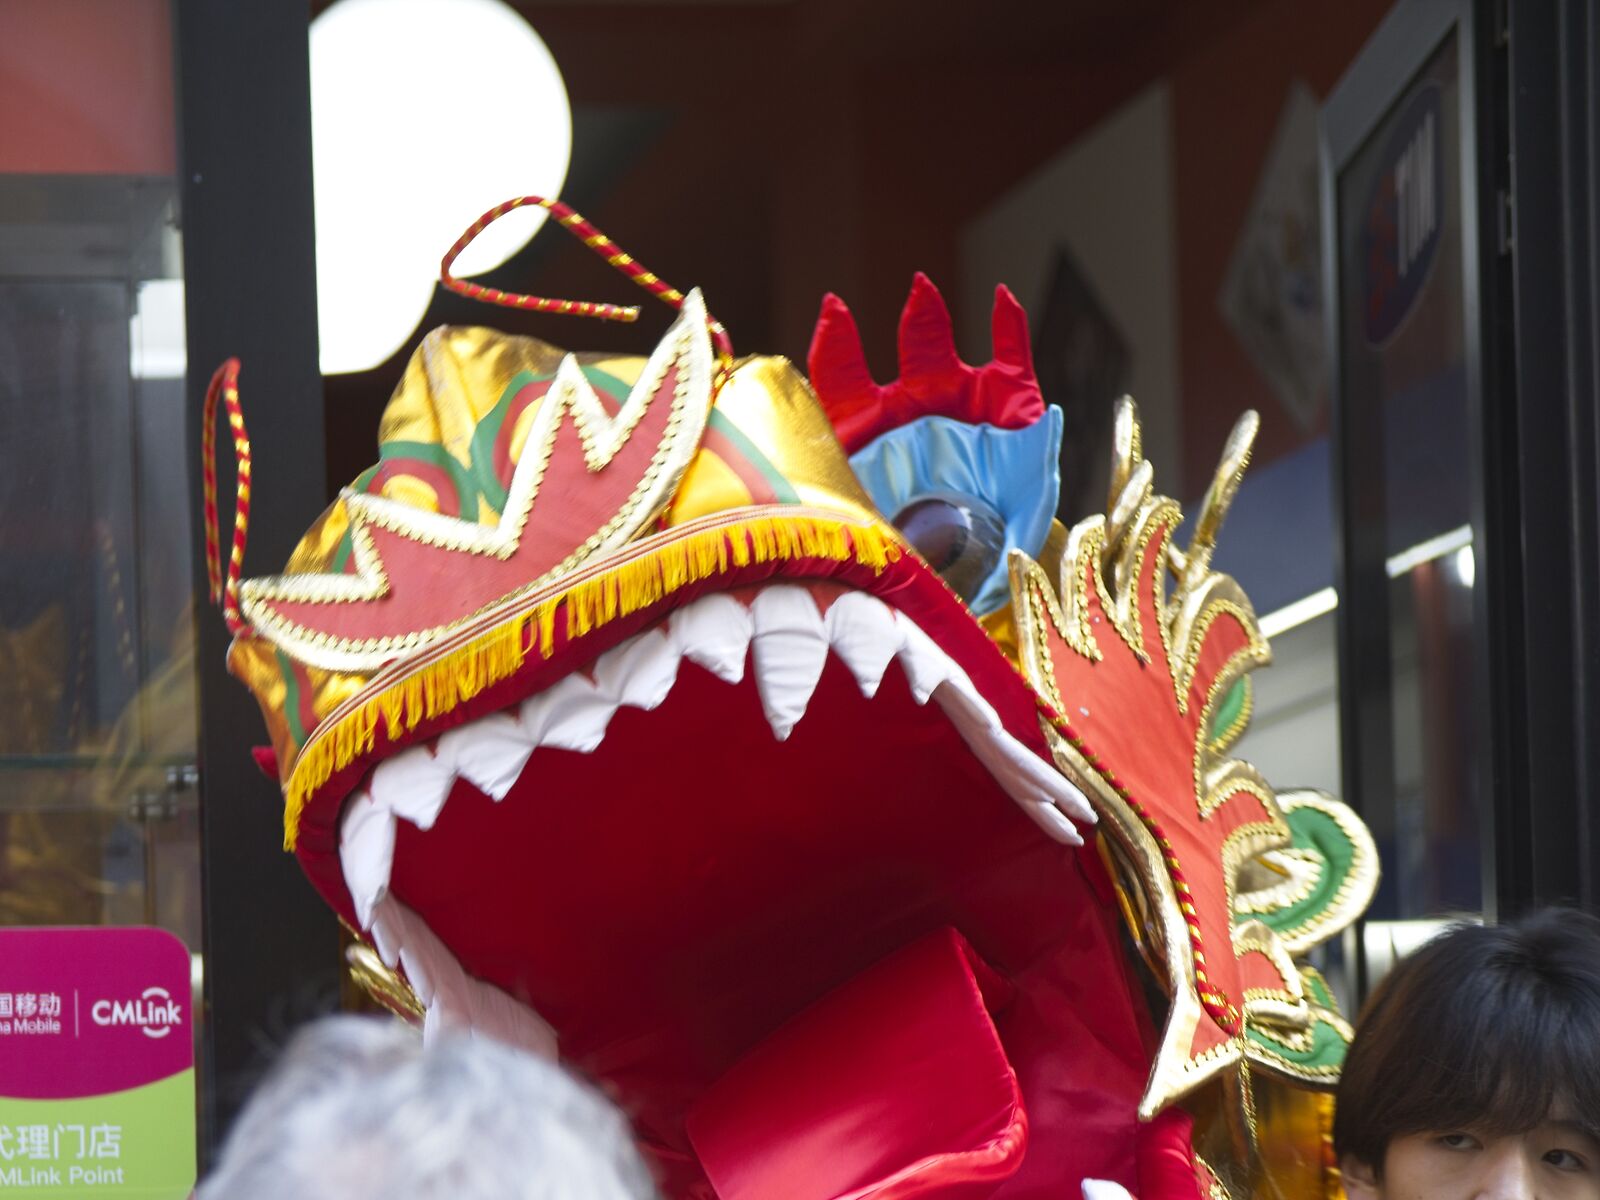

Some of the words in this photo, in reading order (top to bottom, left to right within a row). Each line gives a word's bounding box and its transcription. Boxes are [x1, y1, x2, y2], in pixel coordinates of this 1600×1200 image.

[91, 999, 182, 1026] CMLink
[14, 1018, 61, 1034] Mobile
[69, 1166, 124, 1184] Point
